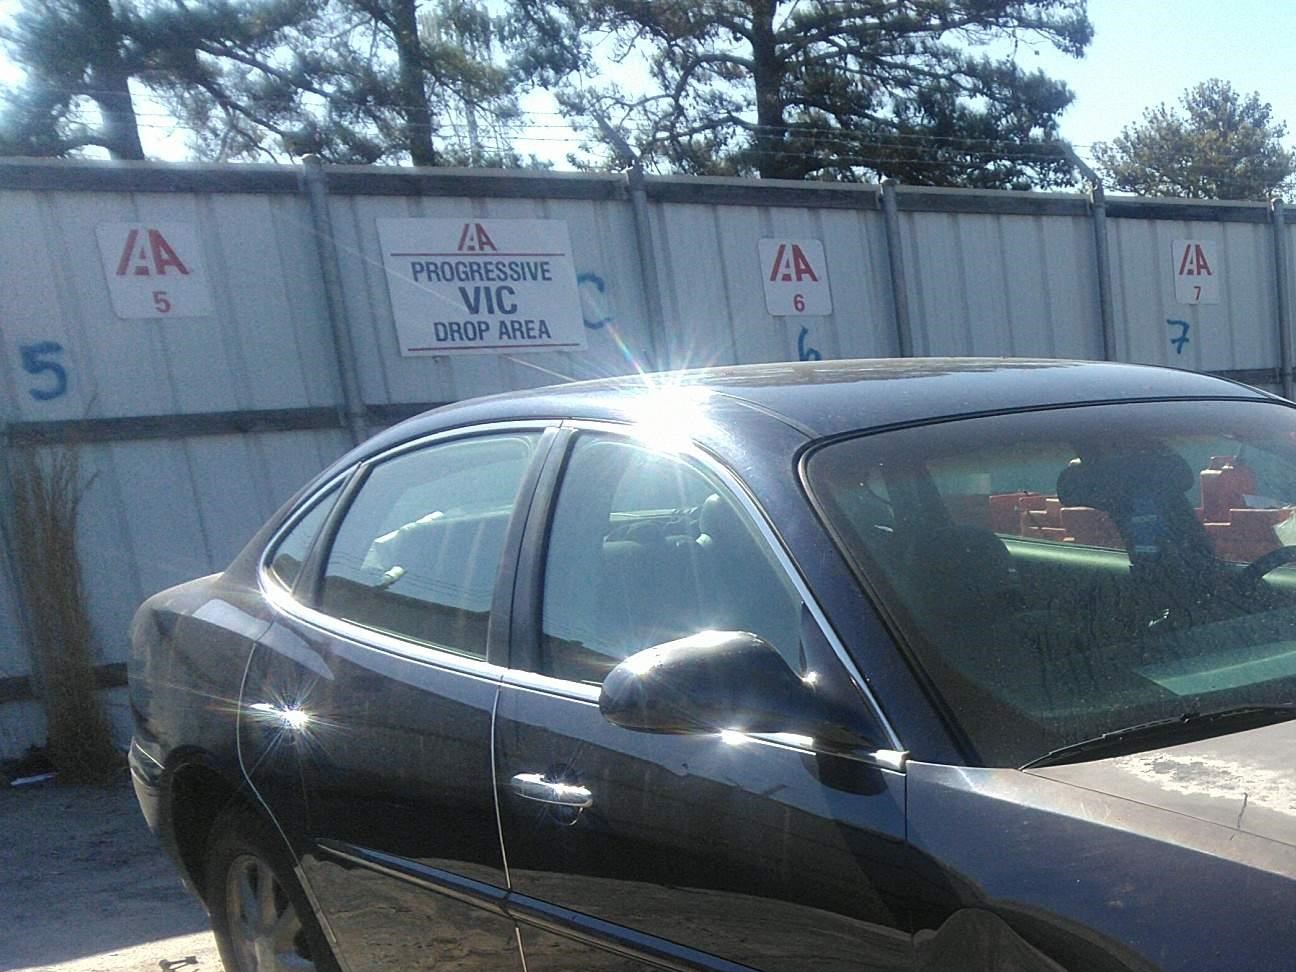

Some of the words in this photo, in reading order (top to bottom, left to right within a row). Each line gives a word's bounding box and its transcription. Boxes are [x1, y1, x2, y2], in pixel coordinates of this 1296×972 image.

[411, 261, 553, 282] PROGRESSIVE
[152, 291, 171, 313] 5
[459, 285, 518, 315] VIC
[793, 294, 805, 312] 6
[1193, 286, 1202, 301] 7
[433, 322, 490, 342] DROP
[499, 320, 552, 340] AREA
[1166, 319, 1190, 354] 7
[19, 341, 67, 401] 5
